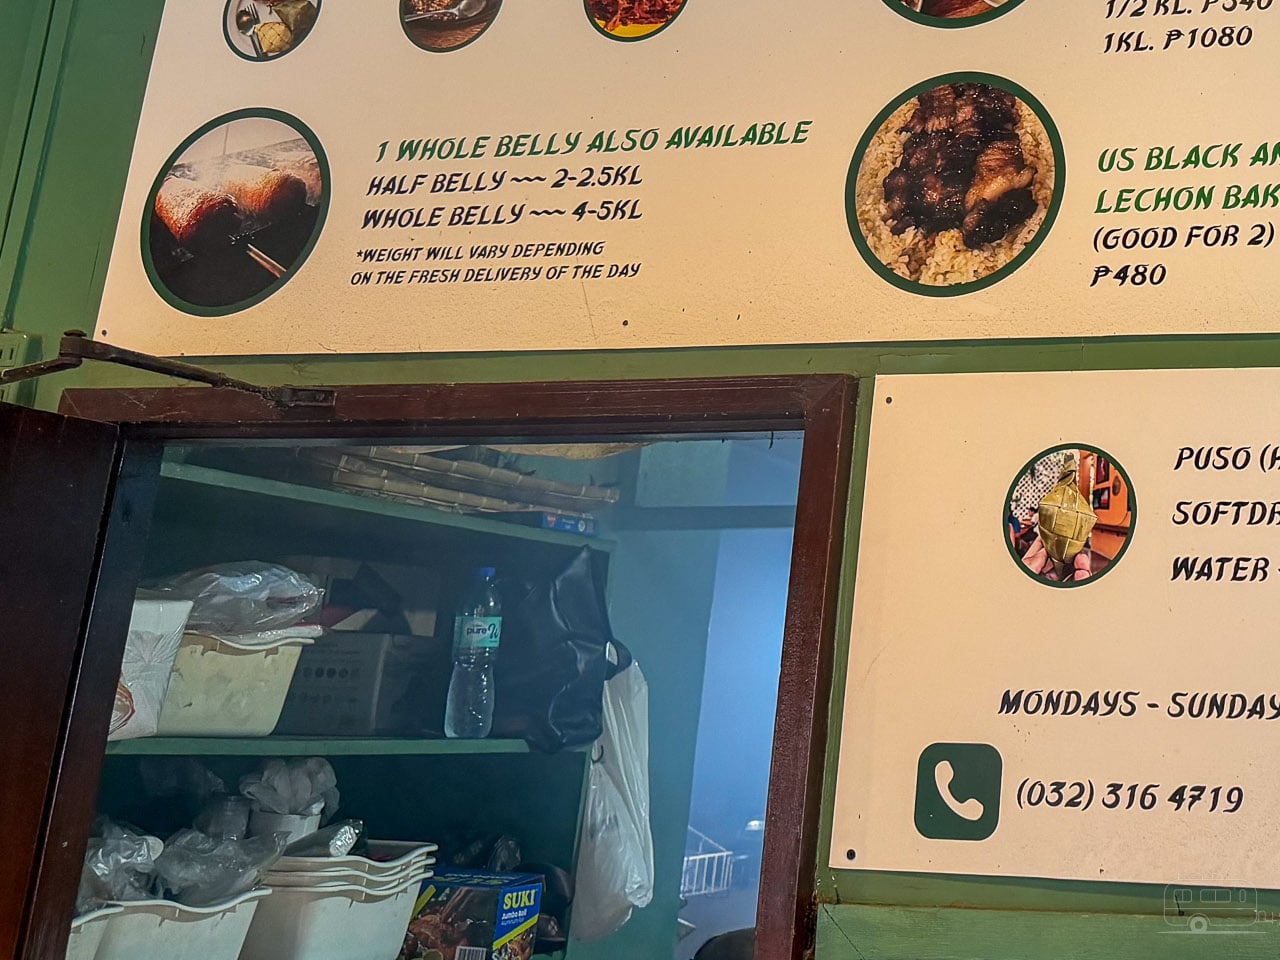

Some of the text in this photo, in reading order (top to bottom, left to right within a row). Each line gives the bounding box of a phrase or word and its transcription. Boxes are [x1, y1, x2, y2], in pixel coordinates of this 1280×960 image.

[1103, 30, 1154, 54] 1KL.
[375, 120, 814, 163] 1 WHOLE BELLY ALSO AVAILABLE
[1098, 147, 1138, 173] US
[1143, 142, 1243, 171] BLACK
[365, 174, 429, 196] HALF
[429, 170, 508, 194] BELLY
[1093, 185, 1216, 214] LECHON
[360, 206, 446, 230] WHOLE
[447, 203, 527, 227] BELLY
[1093, 221, 1275, 253] (GOOD FOR 2)
[425, 245, 464, 261] WILL
[469, 244, 510, 260] VARY
[510, 240, 606, 258] DEPENDING
[350, 262, 642, 286] ON THE FRESH DELIVERY OF THE DAY
[1173, 446, 1252, 471] PUSO
[1170, 556, 1270, 582] WATER
[997, 689, 1141, 717] MONDAYS
[1016, 777, 1244, 813] (032) 316 4719
[503, 889, 536, 910] SUKI
